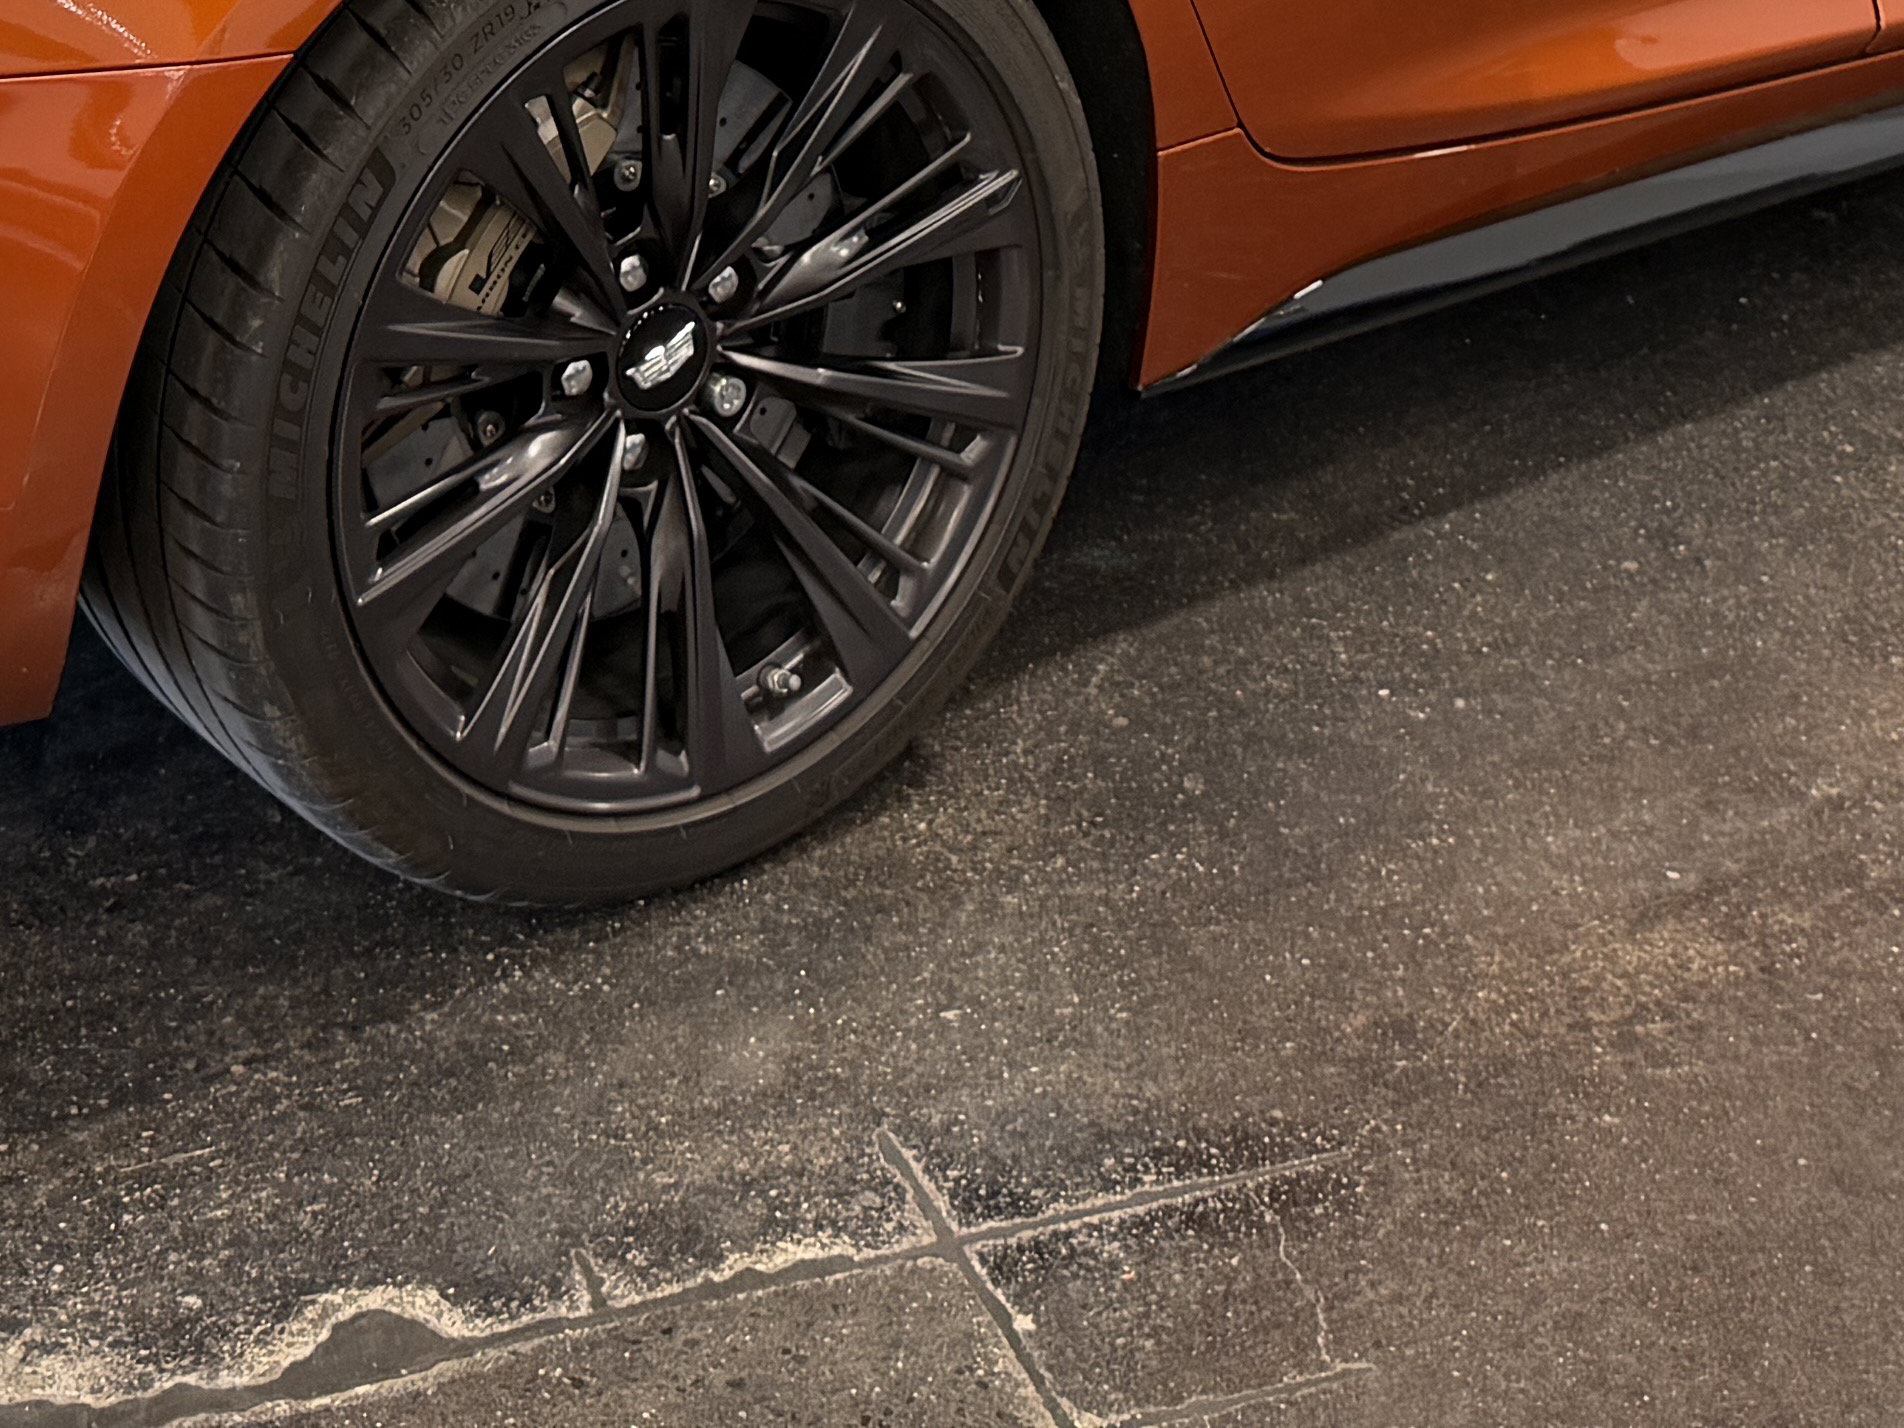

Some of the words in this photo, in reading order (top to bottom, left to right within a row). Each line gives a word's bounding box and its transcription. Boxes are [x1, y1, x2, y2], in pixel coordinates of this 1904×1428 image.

[399, 52, 465, 137] 305/30
[469, 3, 516, 55] ZR19
[268, 167, 386, 500] MICHELIN
